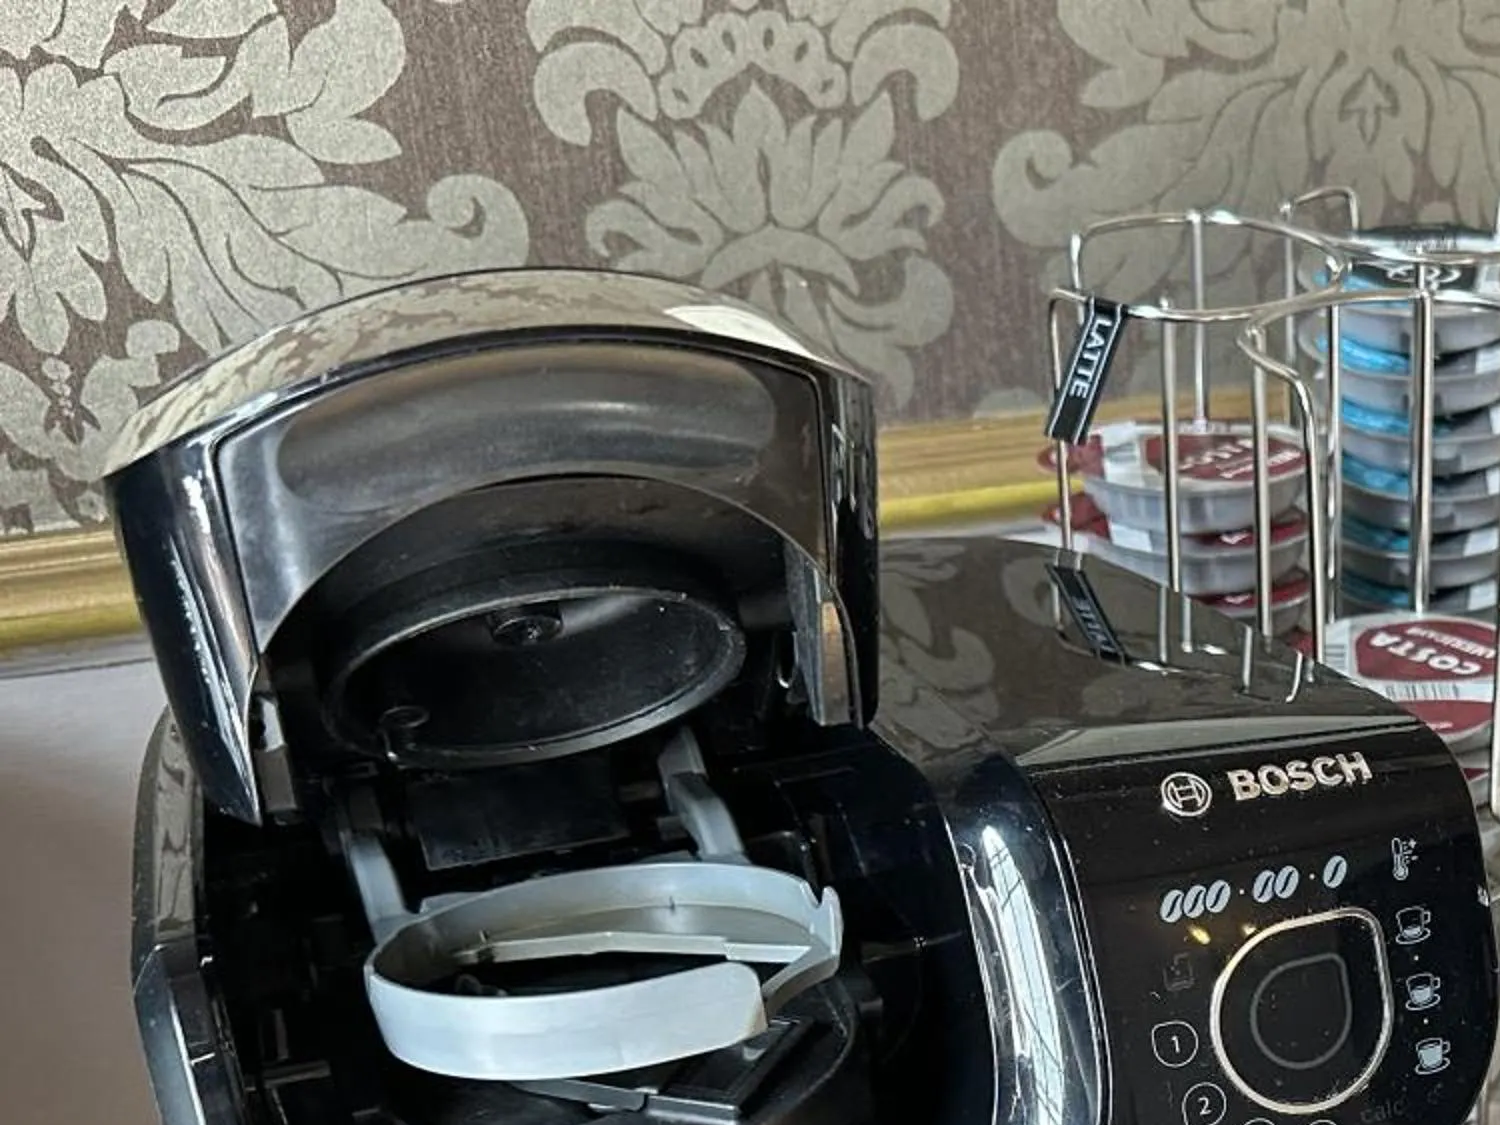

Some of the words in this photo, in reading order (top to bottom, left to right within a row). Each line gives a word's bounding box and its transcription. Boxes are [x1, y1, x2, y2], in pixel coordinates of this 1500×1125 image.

[1069, 318, 1113, 399] LATTE
[1370, 632, 1481, 675] COSTA
[1227, 751, 1373, 801] BOSCH
[1171, 1036, 1181, 1053] 1
[1198, 1097, 1212, 1116] 2
